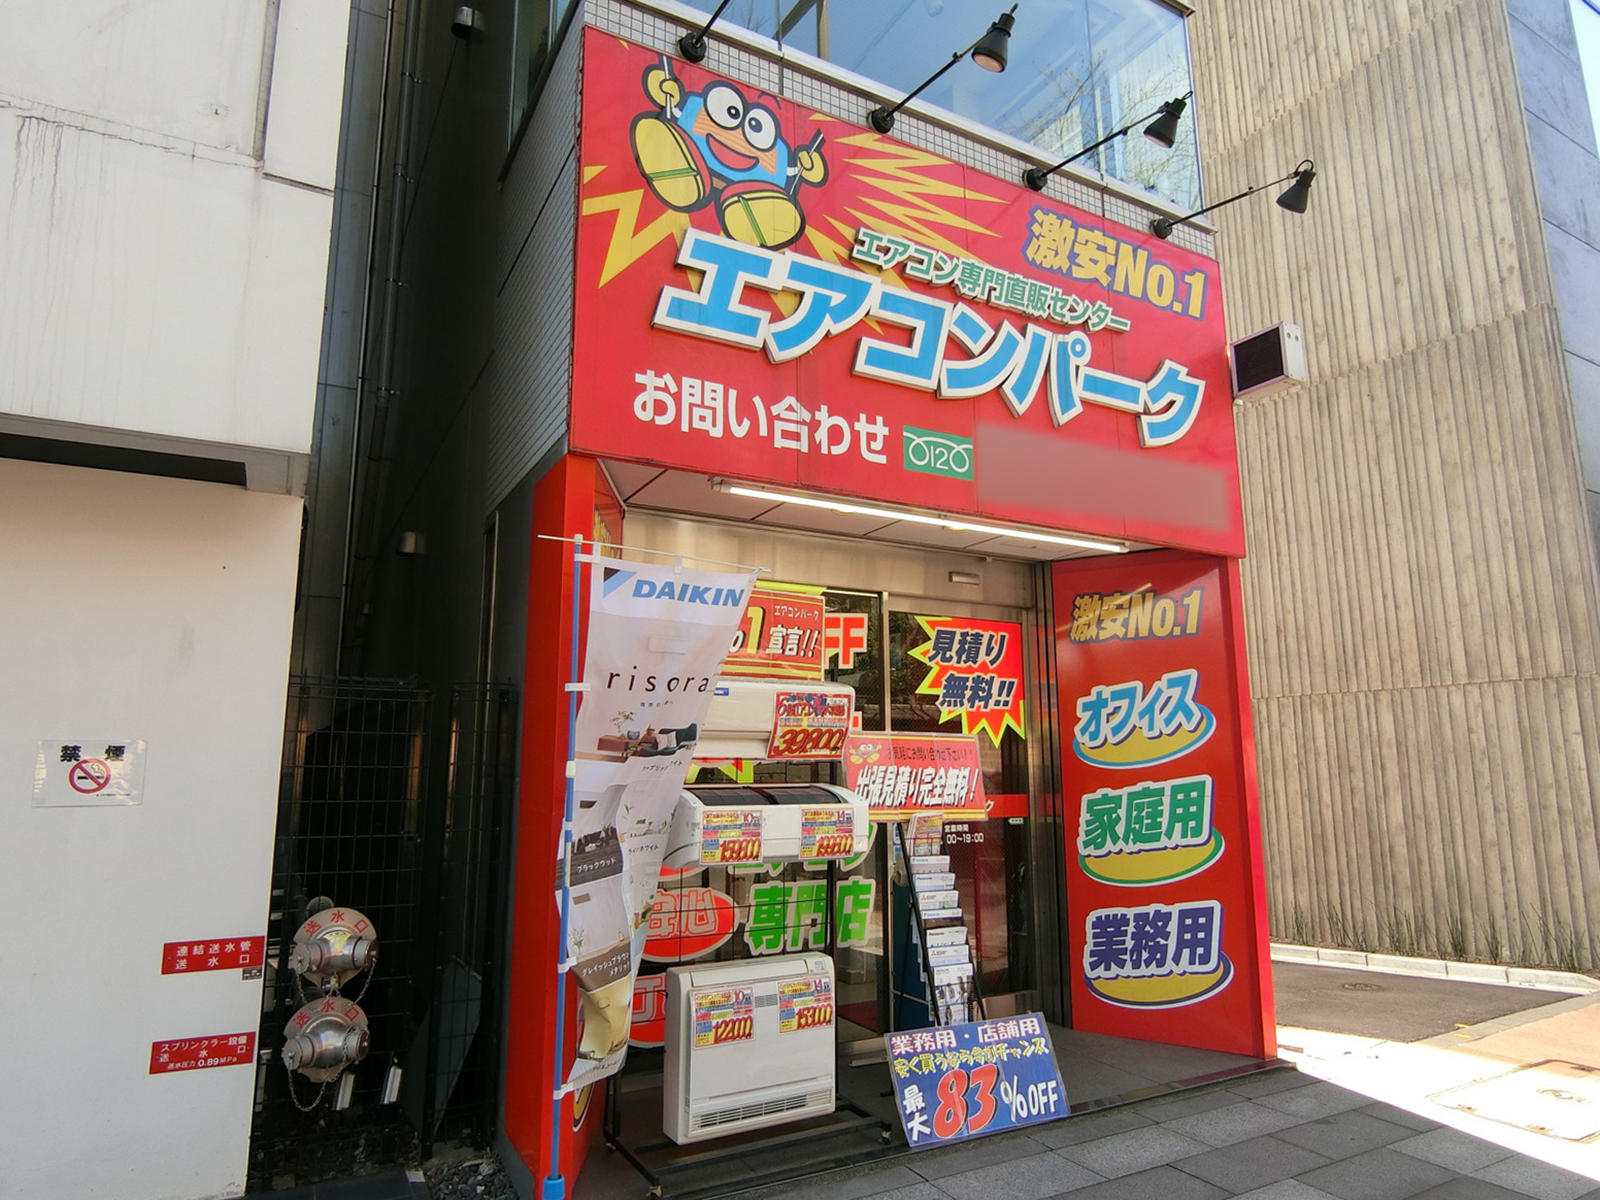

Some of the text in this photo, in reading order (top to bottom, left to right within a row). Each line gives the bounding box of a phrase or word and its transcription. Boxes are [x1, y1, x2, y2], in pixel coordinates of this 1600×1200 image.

[850, 227, 1131, 332] エアコン専門直販センター
[1023, 206, 1207, 320] 激安No.1
[650, 227, 1205, 447] エアコンパーク
[633, 369, 889, 464] お問い合わせ
[908, 437, 970, 473] 0120
[632, 579, 745, 607] DAIKIN
[774, 605, 819, 621] エアコンパーク
[1071, 591, 1202, 643] 激安No.1
[927, 628, 1007, 667] 見積り
[607, 666, 709, 692] risora
[938, 672, 1016, 709] 無料!!
[1075, 670, 1201, 748] オフィス
[60, 745, 126, 762] 禁煙
[855, 765, 979, 807] 出張見積り完全無料!
[944, 824, 969, 832] 営業時間
[1081, 778, 1211, 853] 家庭用
[577, 857, 617, 873] ブラックウッド
[303, 910, 369, 936] 送水口
[746, 880, 873, 950] 専門店
[177, 941, 251, 957] 連結送水管
[1086, 903, 1219, 977] 業務用
[175, 954, 250, 970] 送水口
[293, 999, 360, 1029] 送水口
[159, 1045, 246, 1063] 送水口
[161, 1035, 248, 1053] スプリンクラー設備
[891, 1018, 1041, 1055] 業務用・店舗用
[894, 1037, 1050, 1078] 安く買うなら今がチャンス
[903, 1085, 932, 1142] 最大
